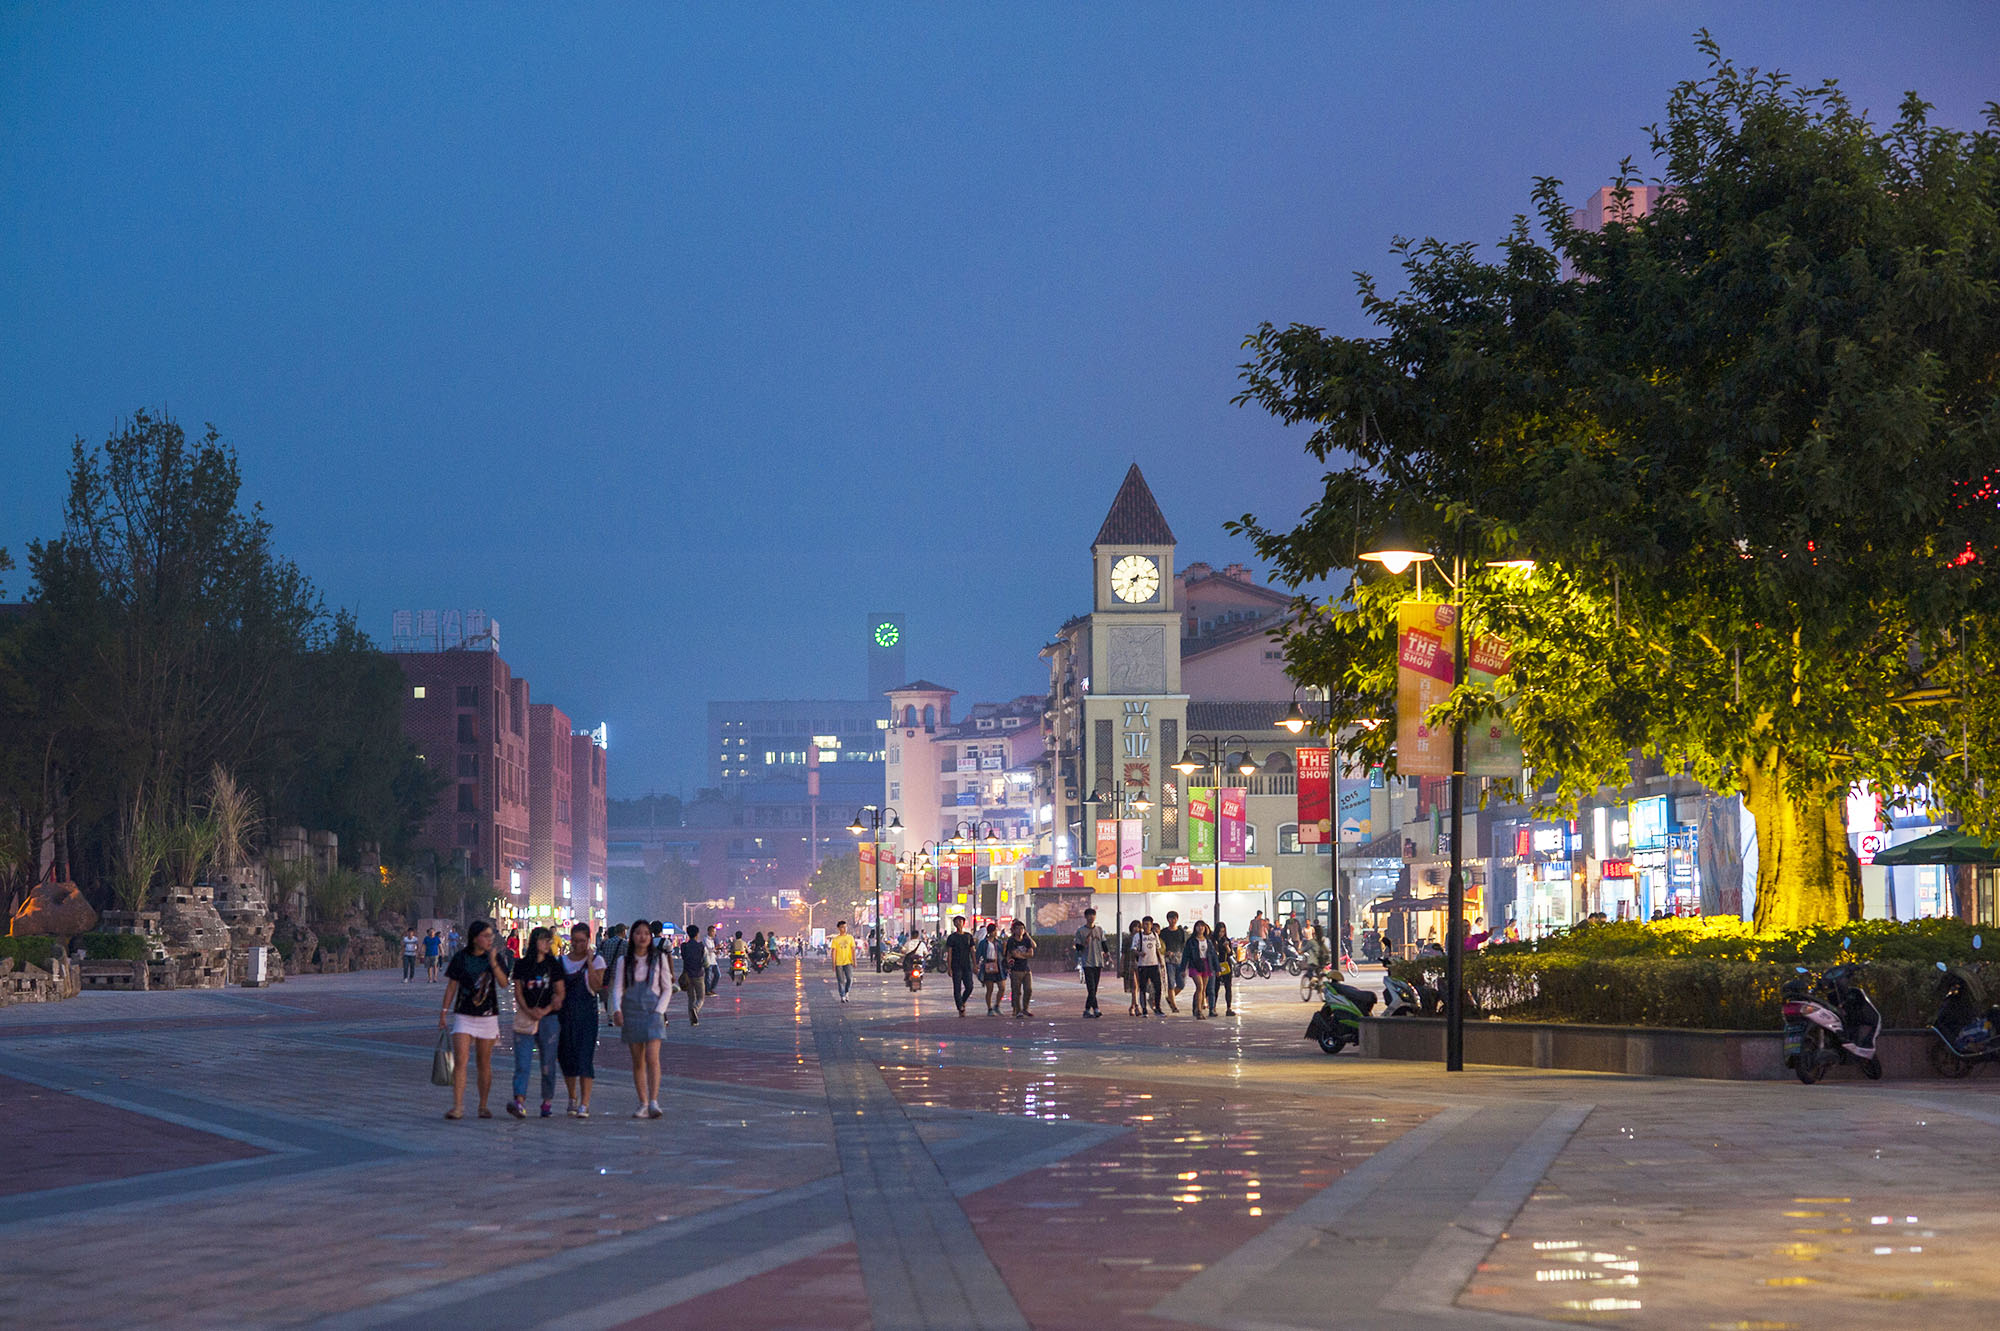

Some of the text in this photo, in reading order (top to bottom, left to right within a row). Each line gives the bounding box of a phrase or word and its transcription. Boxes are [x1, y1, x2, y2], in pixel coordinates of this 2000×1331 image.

[1408, 636, 1438, 657] THE
[1479, 639, 1508, 657] THE
[1402, 652, 1433, 669] SHOW
[1474, 654, 1503, 669] SHOW
[1299, 754, 1330, 767] THE
[1299, 770, 1330, 780] SHOW
[1340, 790, 1359, 806] 2015
[1097, 824, 1117, 833] THE
[1057, 869, 1070, 878] HE
[1171, 865, 1189, 876] THE
